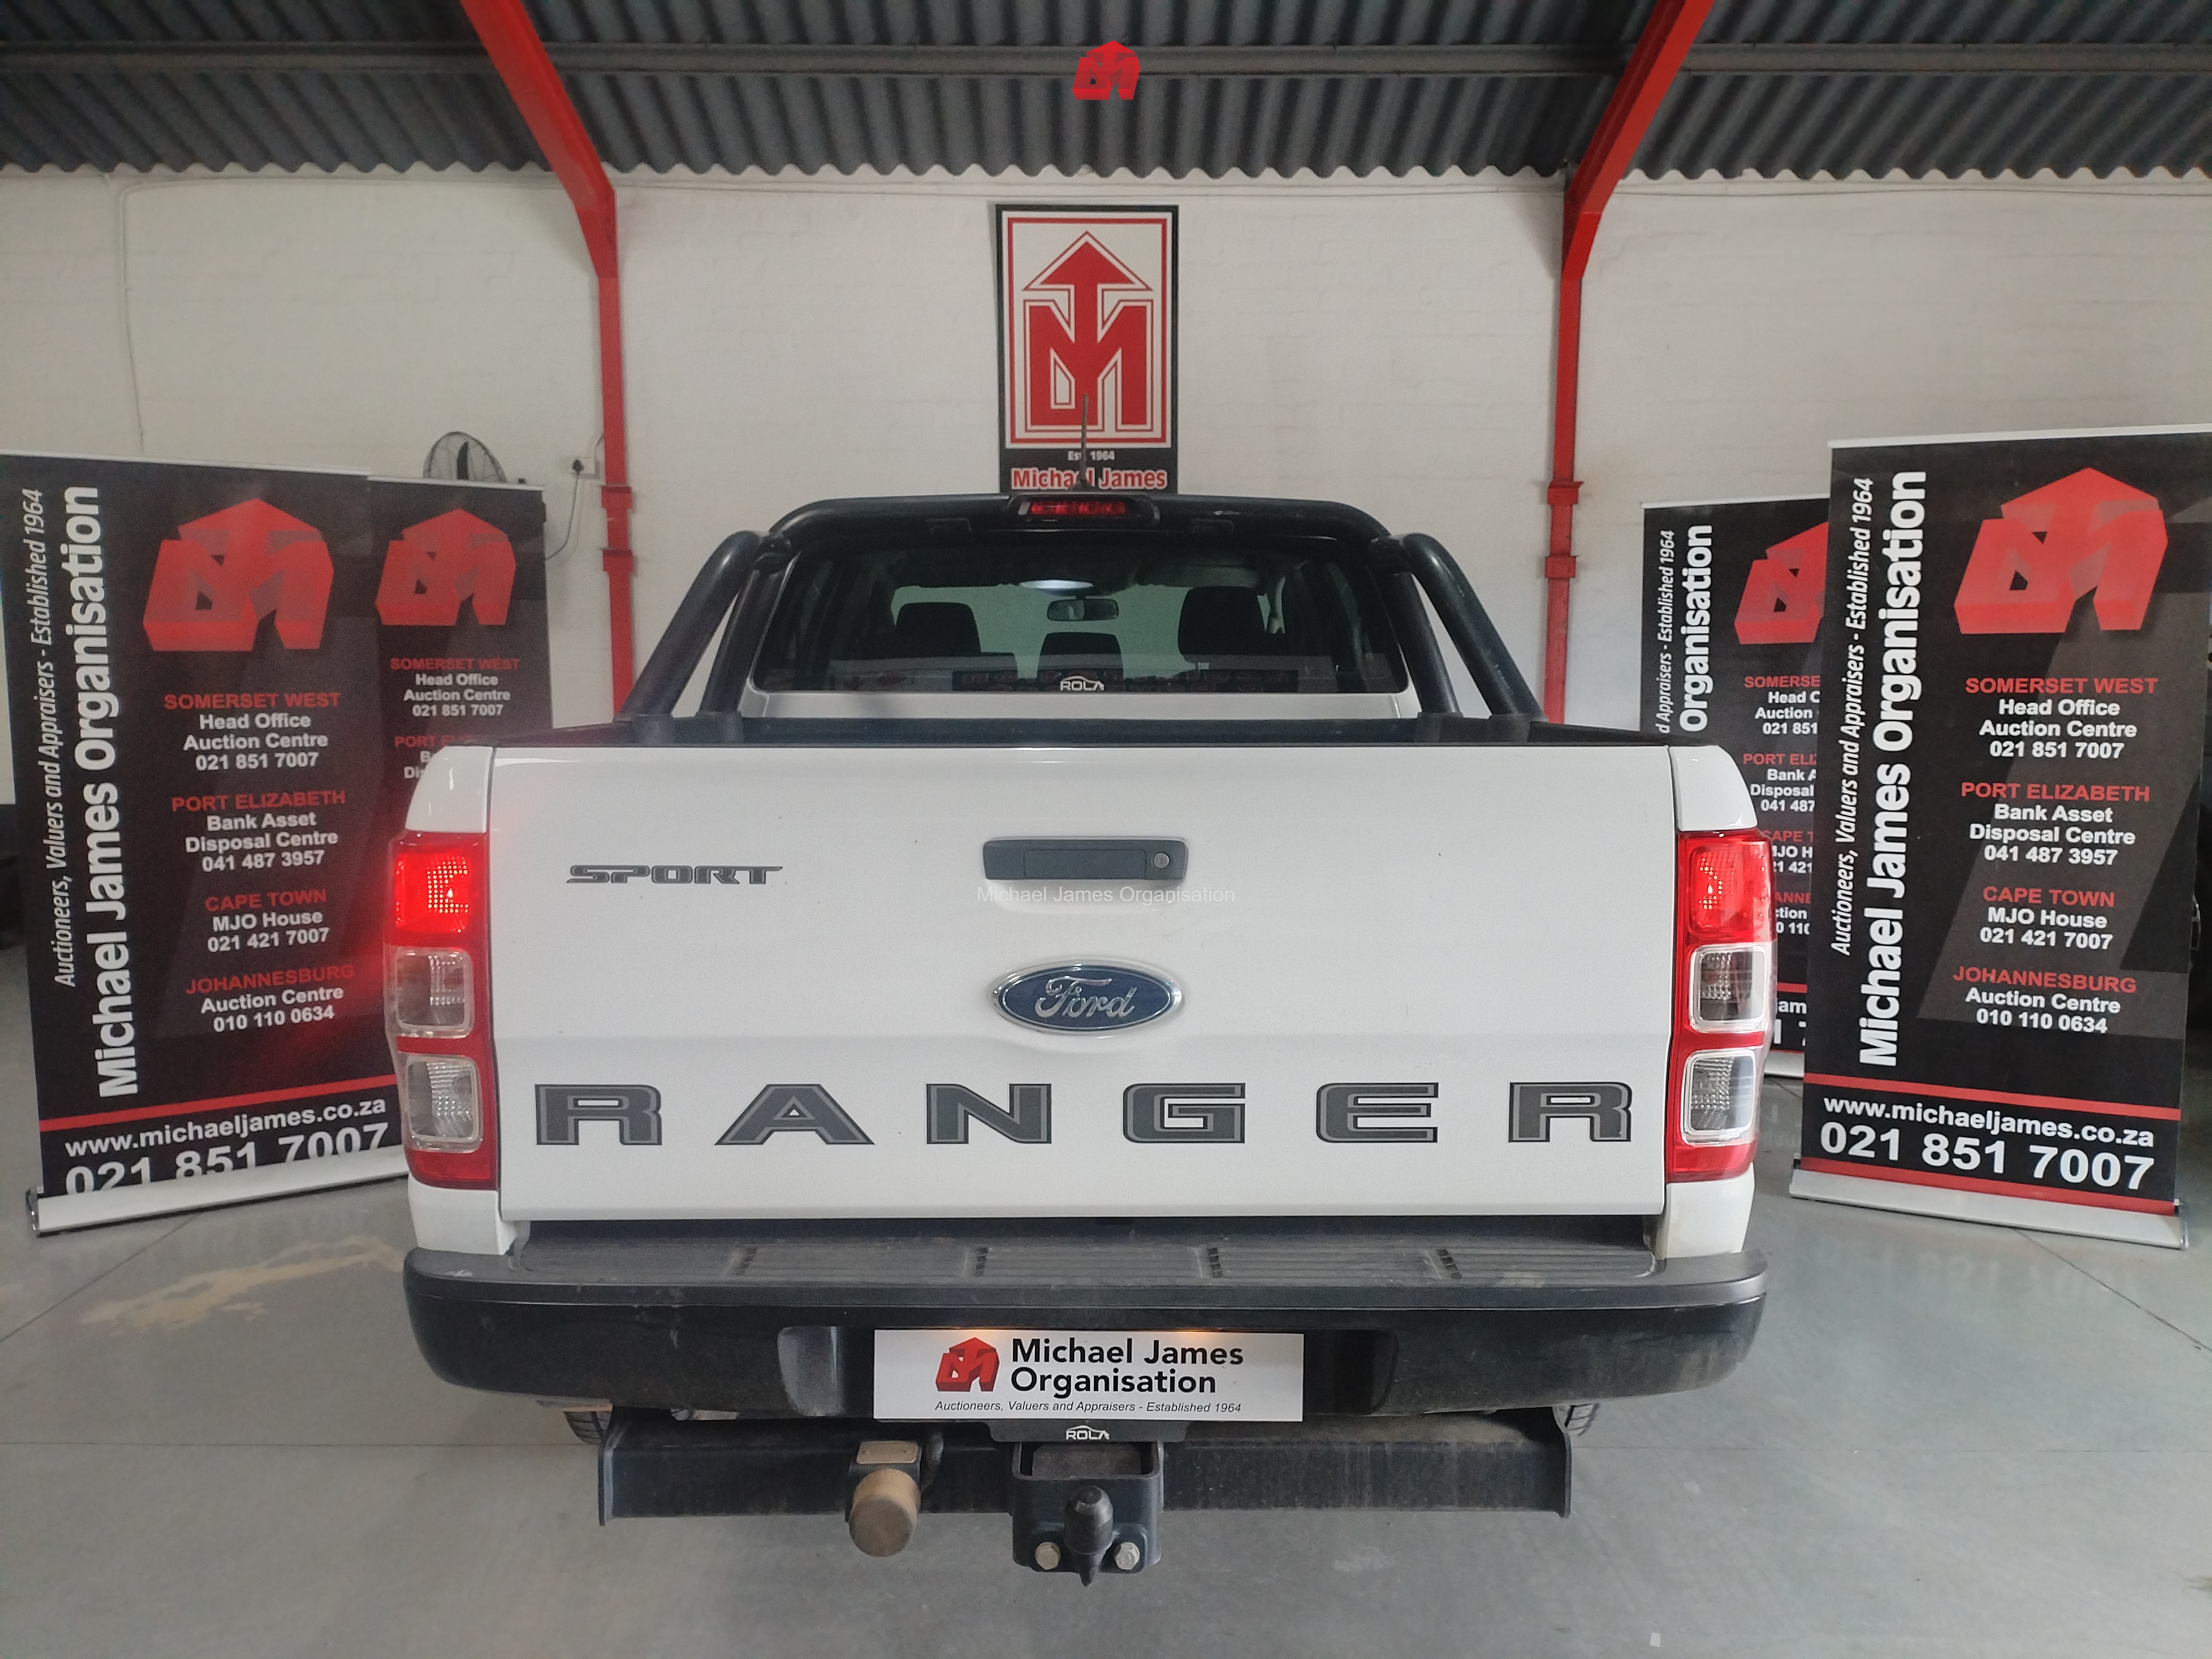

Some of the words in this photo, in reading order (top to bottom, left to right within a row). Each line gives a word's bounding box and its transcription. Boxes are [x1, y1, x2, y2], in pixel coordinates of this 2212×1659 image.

[1068, 450, 1081, 461] Es
[1090, 450, 1115, 461] 1964
[1011, 467, 1096, 490] Michal
[1098, 467, 1168, 490] James
[22, 488, 45, 535] 1964
[1853, 478, 1873, 522] 1964
[1660, 530, 1675, 564] 1964
[1845, 527, 1871, 630] Established
[23, 538, 52, 646] Established
[1657, 566, 1674, 642] Established
[1873, 471, 1926, 751] Organisation
[61, 486, 119, 771] Organisation
[1680, 525, 1713, 732] Organisation
[390, 658, 474, 670] SOMERSET
[478, 658, 521, 670] WEST
[415, 673, 453, 686] Head
[456, 673, 498, 686] Office
[1060, 679, 1104, 691] ROLA
[1656, 652, 1674, 722] Appraisers
[1744, 676, 1820, 688] SOMERSE
[1965, 678, 2088, 695] SOMERSET
[2094, 678, 2159, 694] WEST
[164, 693, 278, 710] SOMERSET
[285, 692, 341, 707] WEST
[403, 689, 460, 702] Auction
[464, 689, 511, 701] Centre
[1768, 691, 1806, 704] Head
[1839, 644, 1865, 739] Appraisers
[33, 660, 64, 758] Appraisers
[412, 704, 437, 717] 021
[442, 704, 466, 717] 851
[470, 704, 503, 717] 7007
[1755, 707, 1813, 719] Auction
[1999, 699, 2052, 716] Head
[2058, 699, 2120, 716] Office
[199, 713, 249, 730] Head
[255, 712, 312, 729] Office
[1763, 723, 1788, 735] 021
[1792, 723, 1818, 735] 851
[1979, 720, 2061, 737] Auction
[2067, 721, 2137, 738] Centre
[183, 734, 259, 751] Auction
[266, 732, 328, 748] Centre
[394, 736, 436, 748] PORT
[1990, 742, 2025, 758] 021
[2032, 742, 2067, 758] 851
[2075, 743, 2124, 759] 7007
[195, 754, 230, 770] 021
[235, 753, 268, 769] 851
[275, 752, 319, 768] 7007
[1743, 753, 1785, 765] PORT
[1839, 740, 1859, 775] and
[37, 760, 63, 798] and
[1767, 768, 1805, 781] Bank
[172, 794, 230, 812] PORT
[235, 790, 346, 810] ELIZABETH
[1750, 784, 1814, 799] Disposal
[1961, 783, 2020, 799] PORT
[2027, 784, 2150, 802] ELIZABETH
[1761, 799, 1785, 812] 041
[1790, 800, 1815, 812] 487
[1835, 778, 1857, 843] Valuers
[1994, 804, 2047, 821] Bank
[2052, 806, 2113, 823] Asset
[207, 814, 257, 832] Bank
[261, 812, 316, 829] Asset
[1866, 764, 1911, 898] James
[43, 801, 67, 869] Valuers
[186, 834, 270, 854] Disposal
[276, 830, 338, 846] Centre
[1970, 823, 2059, 843] Disposal
[2066, 827, 2135, 845] Centre
[83, 782, 126, 921] James
[202, 856, 237, 872] 041
[242, 853, 275, 869] 487
[281, 849, 325, 866] 3957
[1984, 846, 2019, 862] 041
[2026, 847, 2062, 864] 487
[2069, 848, 2118, 866] 3957
[567, 865, 783, 884] SPORT
[205, 894, 261, 912] CAPE
[267, 888, 327, 907] TOWN
[1831, 849, 1858, 956] Auctioneers,
[1982, 886, 2041, 904] CAPE
[2048, 889, 2115, 908] TOWN
[213, 913, 257, 932] MJO
[262, 911, 323, 928] House
[1776, 907, 1808, 920] tion
[1987, 907, 2034, 925] MJO
[2040, 910, 2107, 929] House
[51, 875, 76, 987] Auctioneers,
[207, 936, 240, 953] 021
[247, 933, 280, 950] 421
[287, 927, 330, 946] 7007
[1980, 928, 2014, 945] 021
[2021, 930, 2056, 947] 421
[2065, 933, 2113, 950] 7007
[186, 965, 355, 995] JOHANNESBURG
[1859, 908, 1904, 1067] Michael
[1953, 966, 2136, 994] JOHANNESBURG
[200, 993, 276, 1014] Auction
[281, 986, 344, 1006] Centre
[1034, 976, 1136, 1018] Ford
[1966, 987, 2045, 1009] Auction
[2052, 993, 2121, 1014] Centre
[86, 931, 138, 1097] Michael
[213, 1016, 247, 1033] 010
[253, 1011, 285, 1028] 110
[290, 1005, 334, 1024] 0634
[1977, 1009, 2012, 1026] 010
[2019, 1013, 2052, 1030] 110
[2059, 1016, 2107, 1034] 0634
[536, 1082, 1633, 1145] RANGER
[1824, 1095, 2154, 1148] www.michaeljames.co.za
[65, 1098, 386, 1158] www.michaeljames.co.za
[65, 1156, 151, 1196] 021
[176, 1141, 256, 1180] 851
[278, 1122, 389, 1164] 7007
[1820, 1121, 1900, 1161] 021
[1922, 1133, 2006, 1174] 851
[2029, 1145, 2155, 1190] 7007
[1012, 1337, 1132, 1364] Michael
[1144, 1340, 1244, 1365] James
[1011, 1366, 1217, 1399] Organisation
[935, 1400, 1003, 1412] Auctioneers,
[1008, 1401, 1049, 1411] Valuers
[1053, 1401, 1073, 1411] and
[1076, 1401, 1135, 1413] Appraisers
[1147, 1402, 1210, 1413] Established
[1215, 1402, 1242, 1413] 1964
[1066, 1428, 1110, 1440] ROLA
